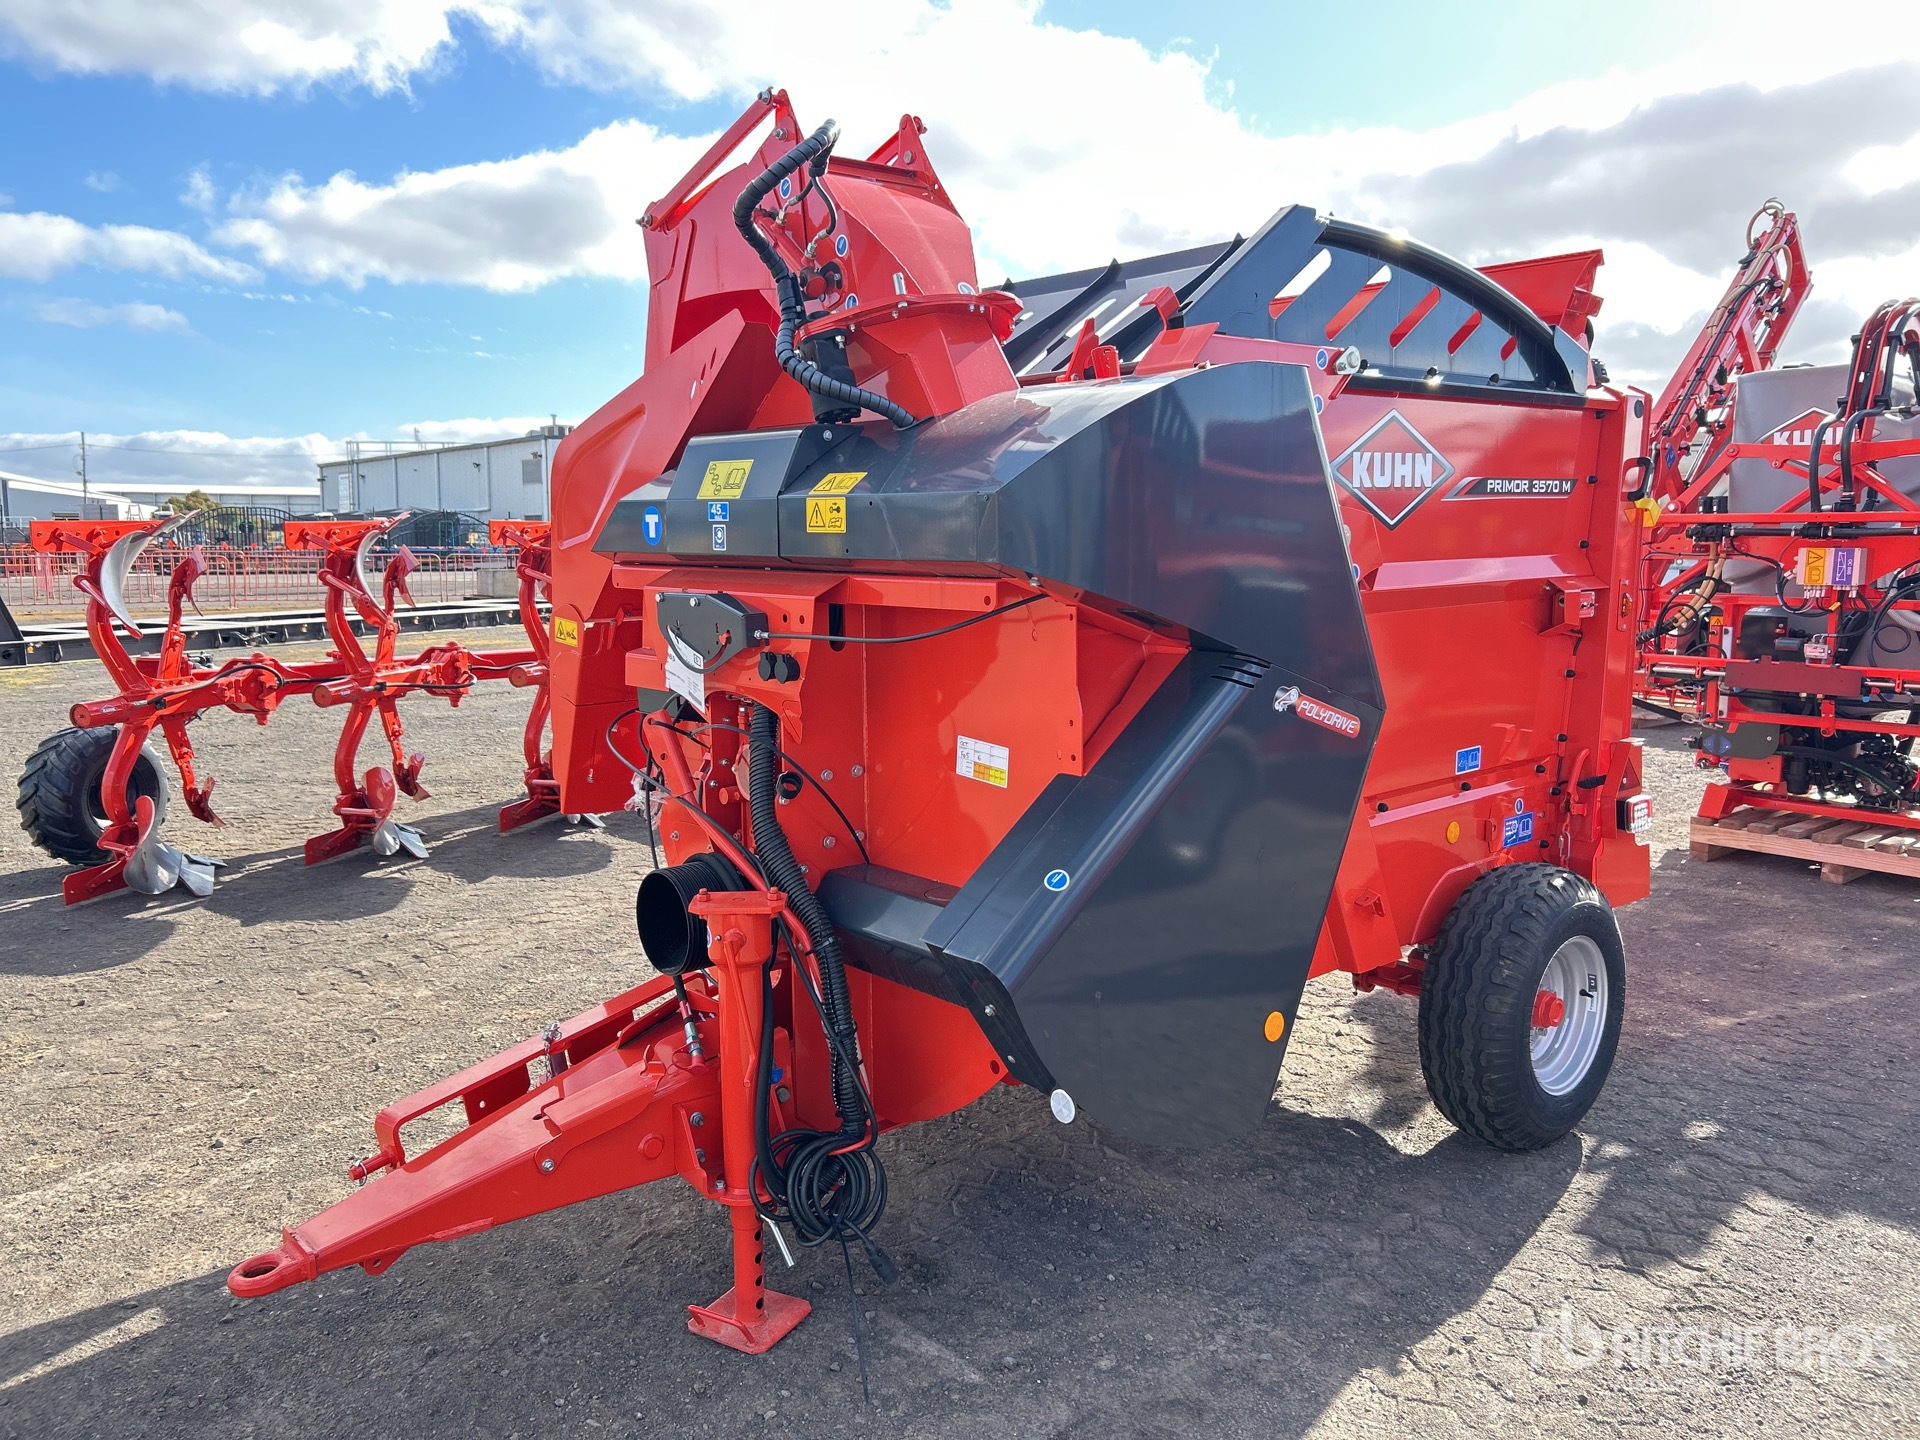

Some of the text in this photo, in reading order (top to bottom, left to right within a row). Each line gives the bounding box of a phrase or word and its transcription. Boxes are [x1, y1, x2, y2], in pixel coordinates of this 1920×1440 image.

[1352, 451, 1433, 489] KUHN
[1487, 479, 1571, 493] PRIMOR 3570 M
[710, 503, 722, 515] 45
[645, 514, 659, 539] T
[1297, 700, 1358, 734] POLYDRIVE
